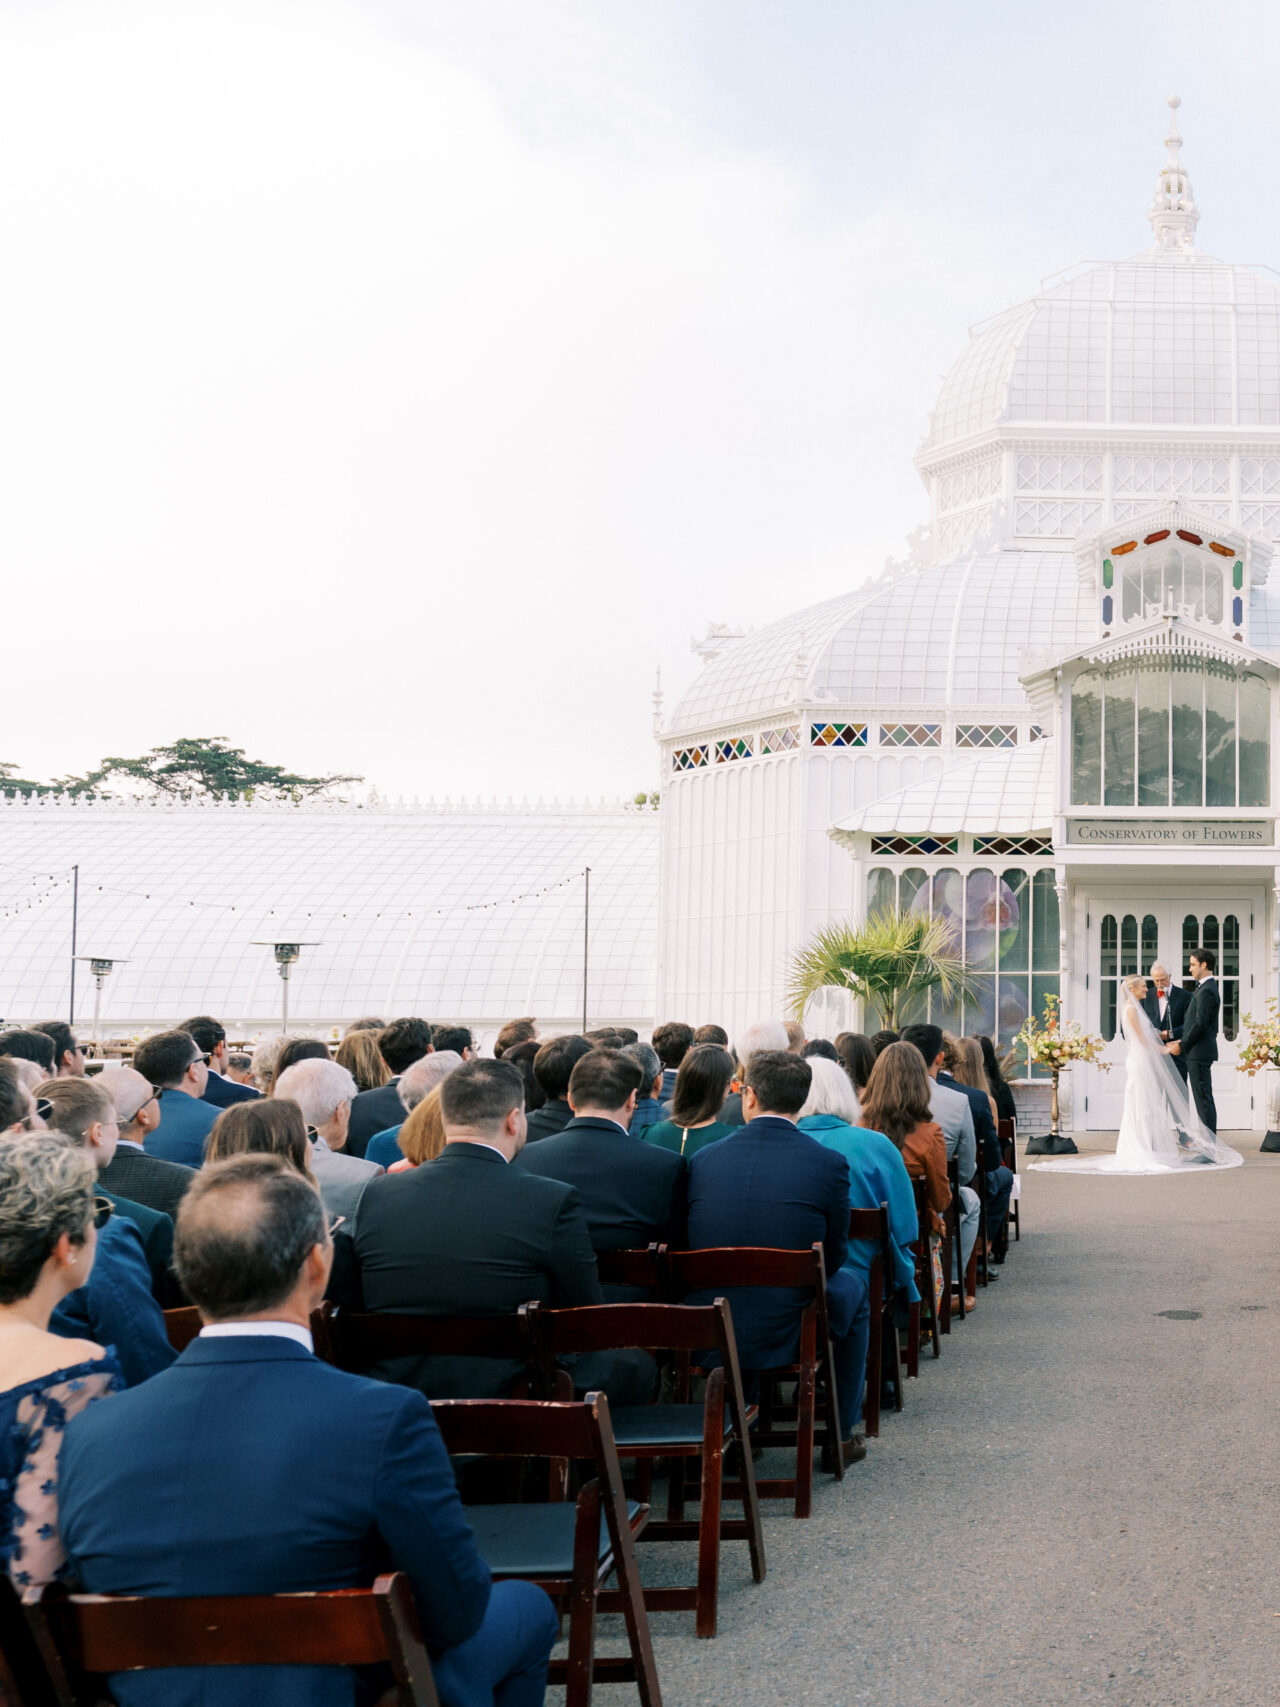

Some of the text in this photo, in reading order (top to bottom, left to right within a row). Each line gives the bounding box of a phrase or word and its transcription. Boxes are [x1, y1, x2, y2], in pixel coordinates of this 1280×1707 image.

[1078, 825, 1263, 840] CONSERVATORY OF FLOWERS
